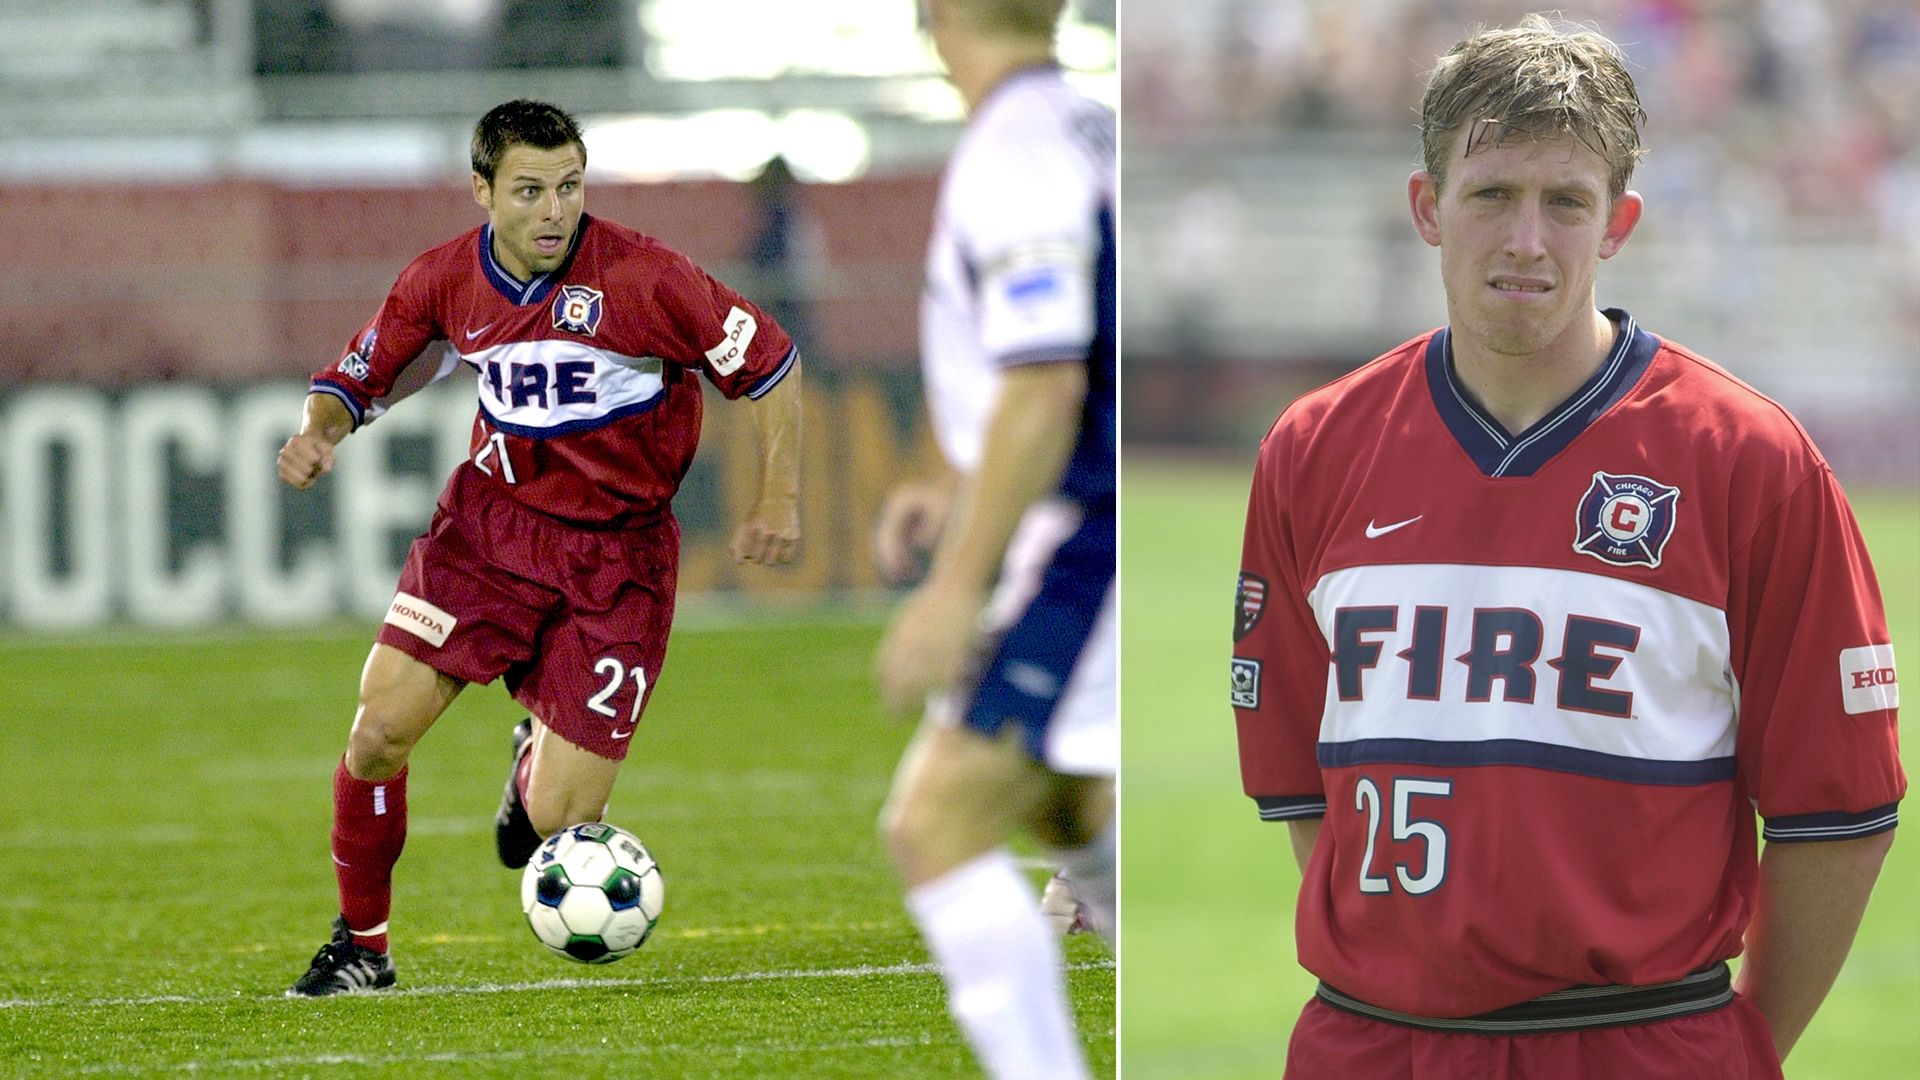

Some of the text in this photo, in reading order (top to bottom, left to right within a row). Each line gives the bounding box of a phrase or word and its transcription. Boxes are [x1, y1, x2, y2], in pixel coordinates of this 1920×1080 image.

[570, 303, 583, 319] C
[716, 319, 747, 367] HODA
[461, 357, 597, 409] IRE
[1615, 483, 1654, 497] CHICAGO
[1611, 501, 1640, 533] C
[1607, 545, 1628, 556] FIRE
[392, 603, 444, 635] HONDA
[1330, 605, 1641, 719] FIRE
[587, 657, 647, 723] 21
[1231, 690, 1255, 704] LS
[1355, 776, 1453, 895] 25
